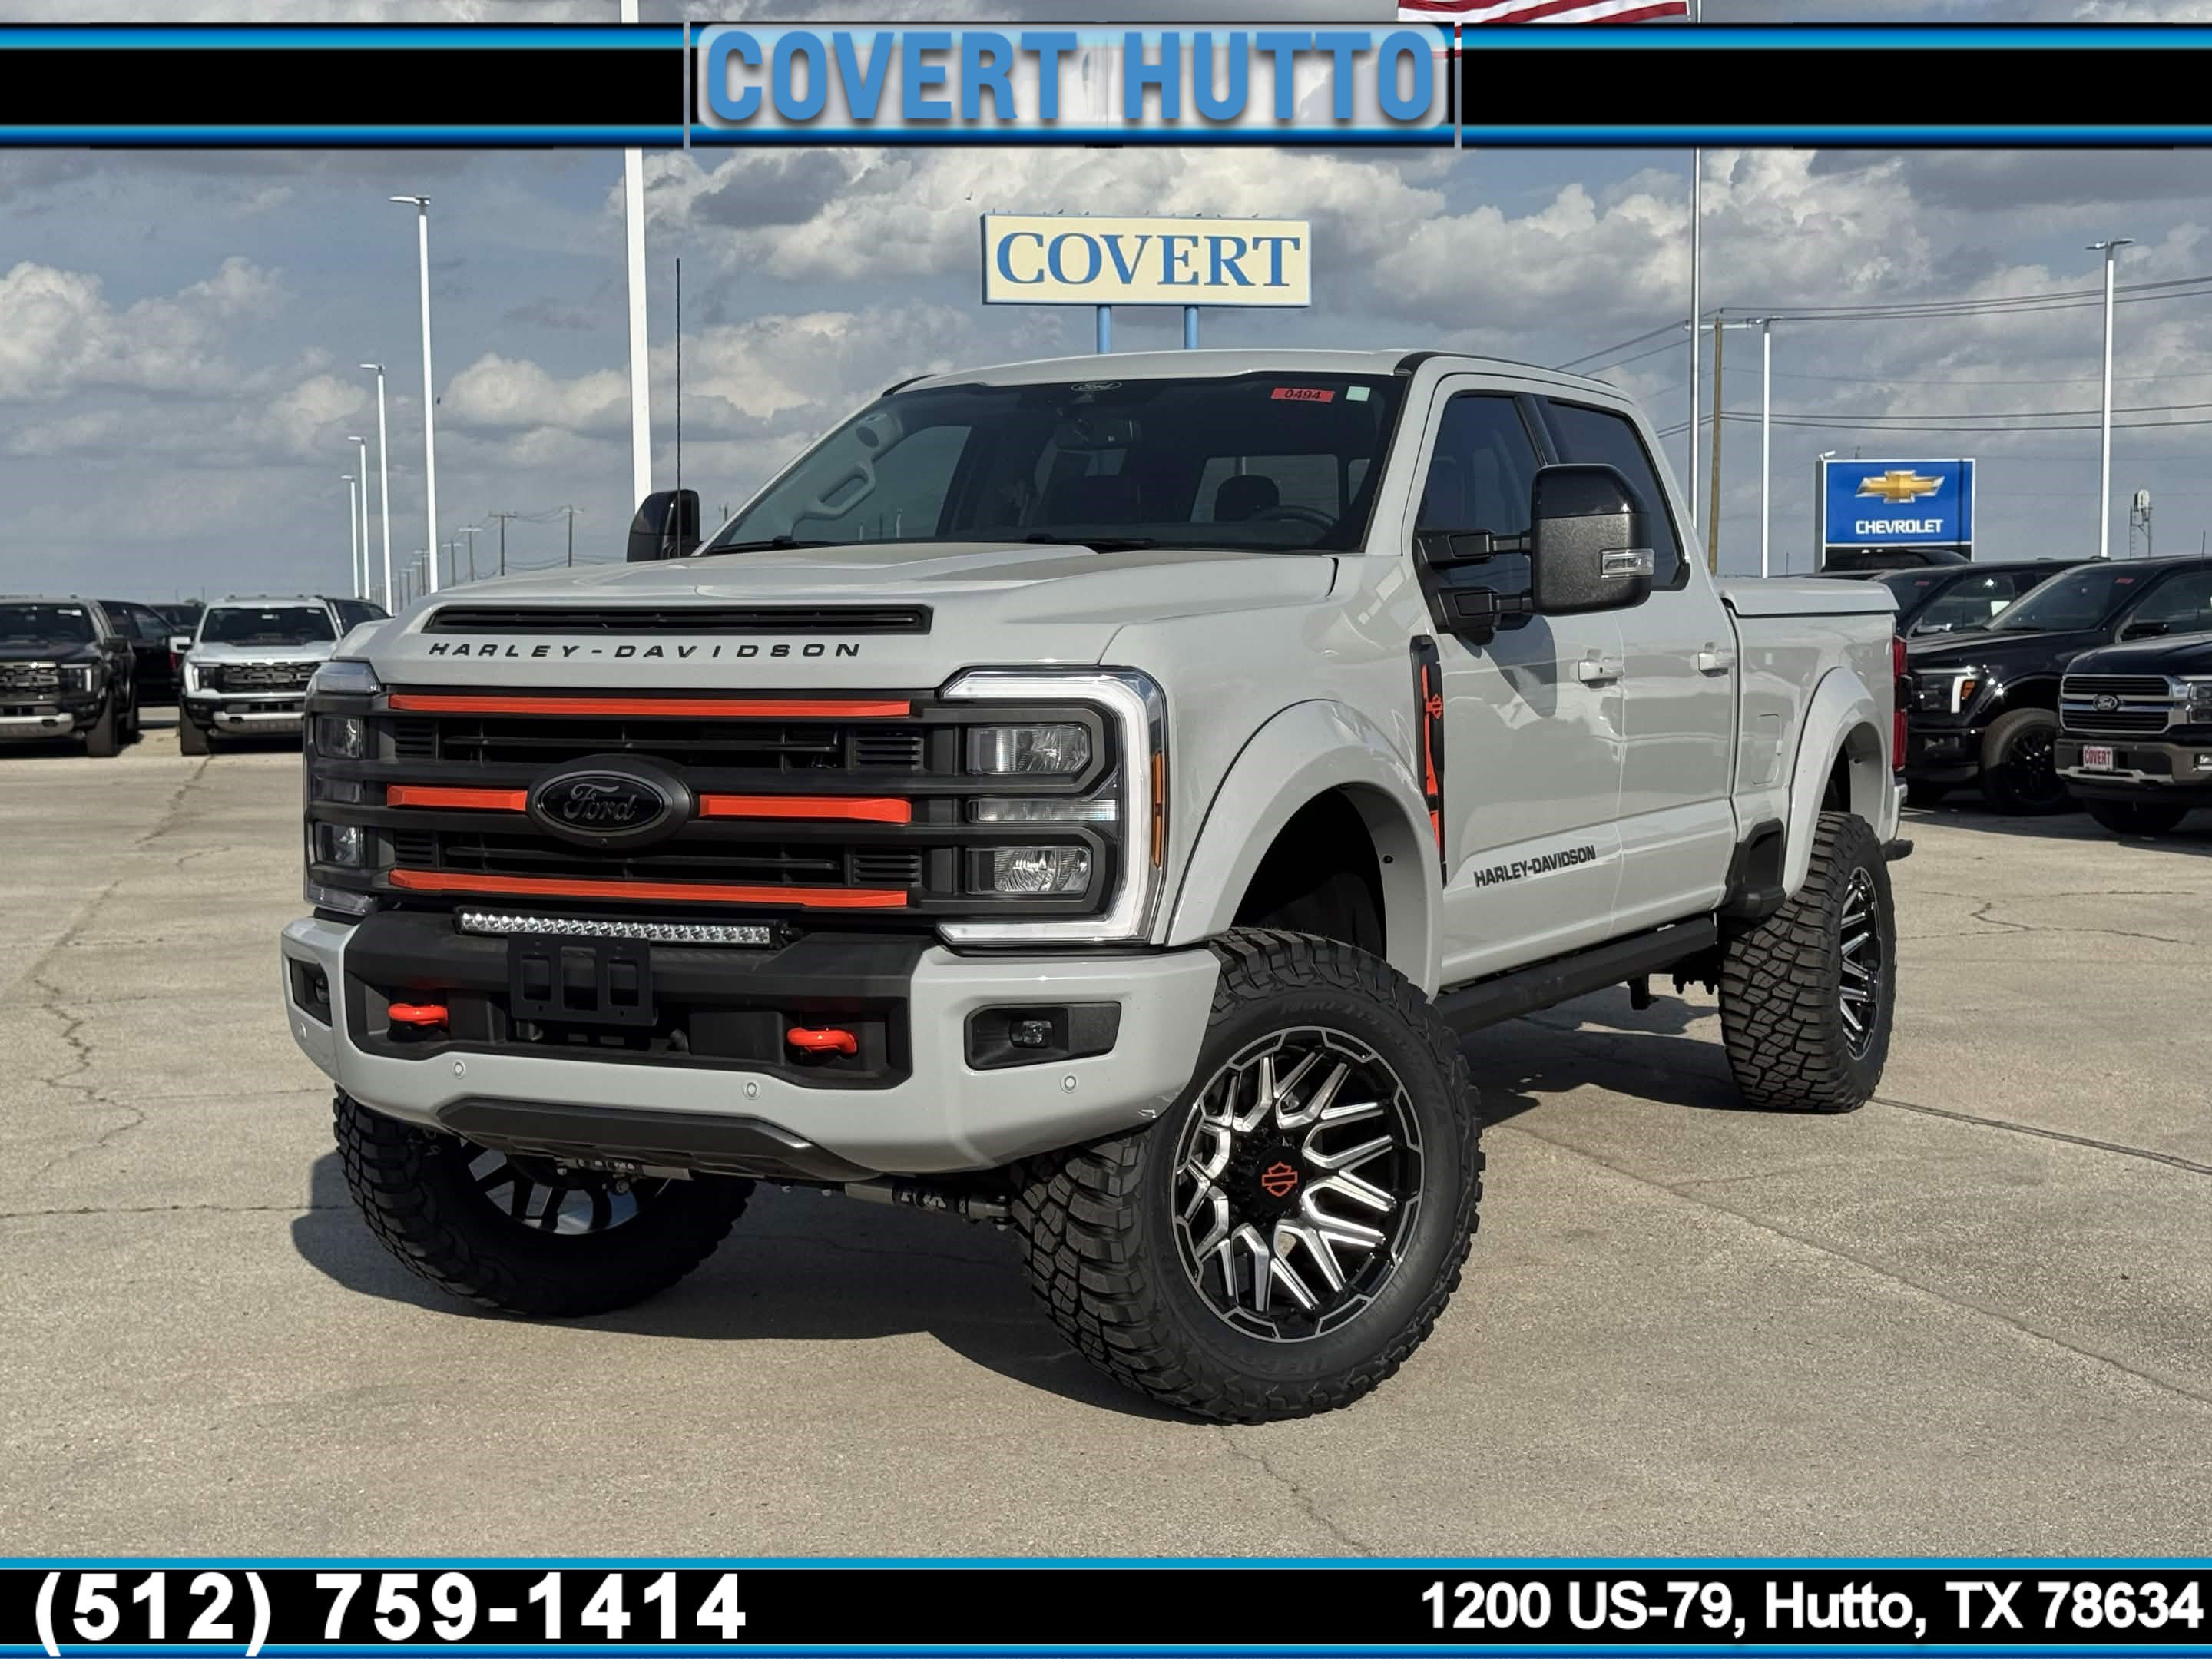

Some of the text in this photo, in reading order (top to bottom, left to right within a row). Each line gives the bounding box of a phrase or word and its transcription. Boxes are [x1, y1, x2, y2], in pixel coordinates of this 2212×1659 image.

[996, 232, 1300, 287] COVERT
[1284, 389, 1322, 399] 0494
[1855, 518, 1944, 535] CHEVROLET
[429, 643, 860, 658] HARLEY-DAVIDSON
[2085, 749, 2111, 766] COVERT
[563, 783, 637, 820] Ford
[1473, 845, 1596, 888] HARLEY-DAVIDSON
